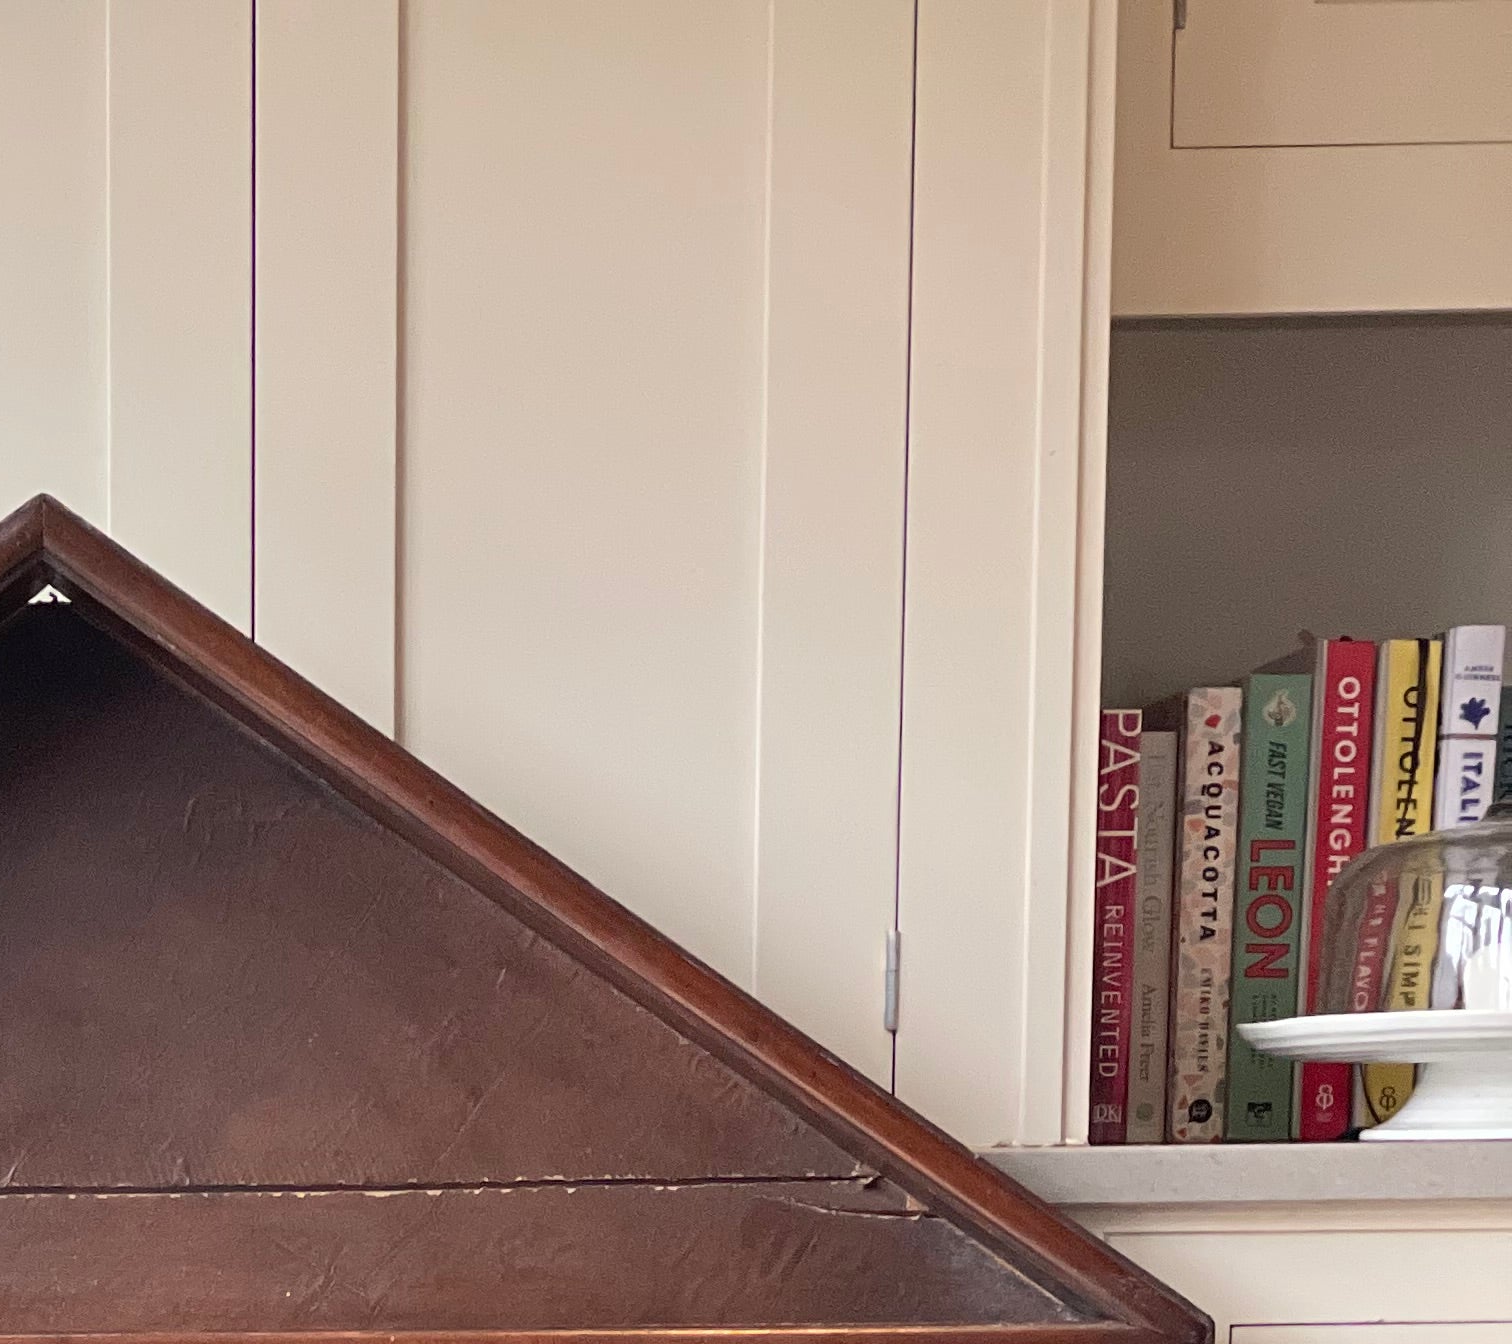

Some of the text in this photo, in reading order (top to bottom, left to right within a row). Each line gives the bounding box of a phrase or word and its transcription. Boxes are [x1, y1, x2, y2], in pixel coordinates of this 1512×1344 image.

[1199, 740, 1226, 941] ACQUACOTTA
[1264, 740, 1288, 831] FAST VEGAN
[1327, 675, 1361, 886] OTTOLENGH
[1353, 938, 1379, 1012] FLAVO
[1457, 752, 1484, 824] ITALI
[1096, 709, 1143, 1079] PASTA REINVENTED
[1244, 839, 1296, 979] LEON
[1399, 944, 1423, 1008] SIMP
